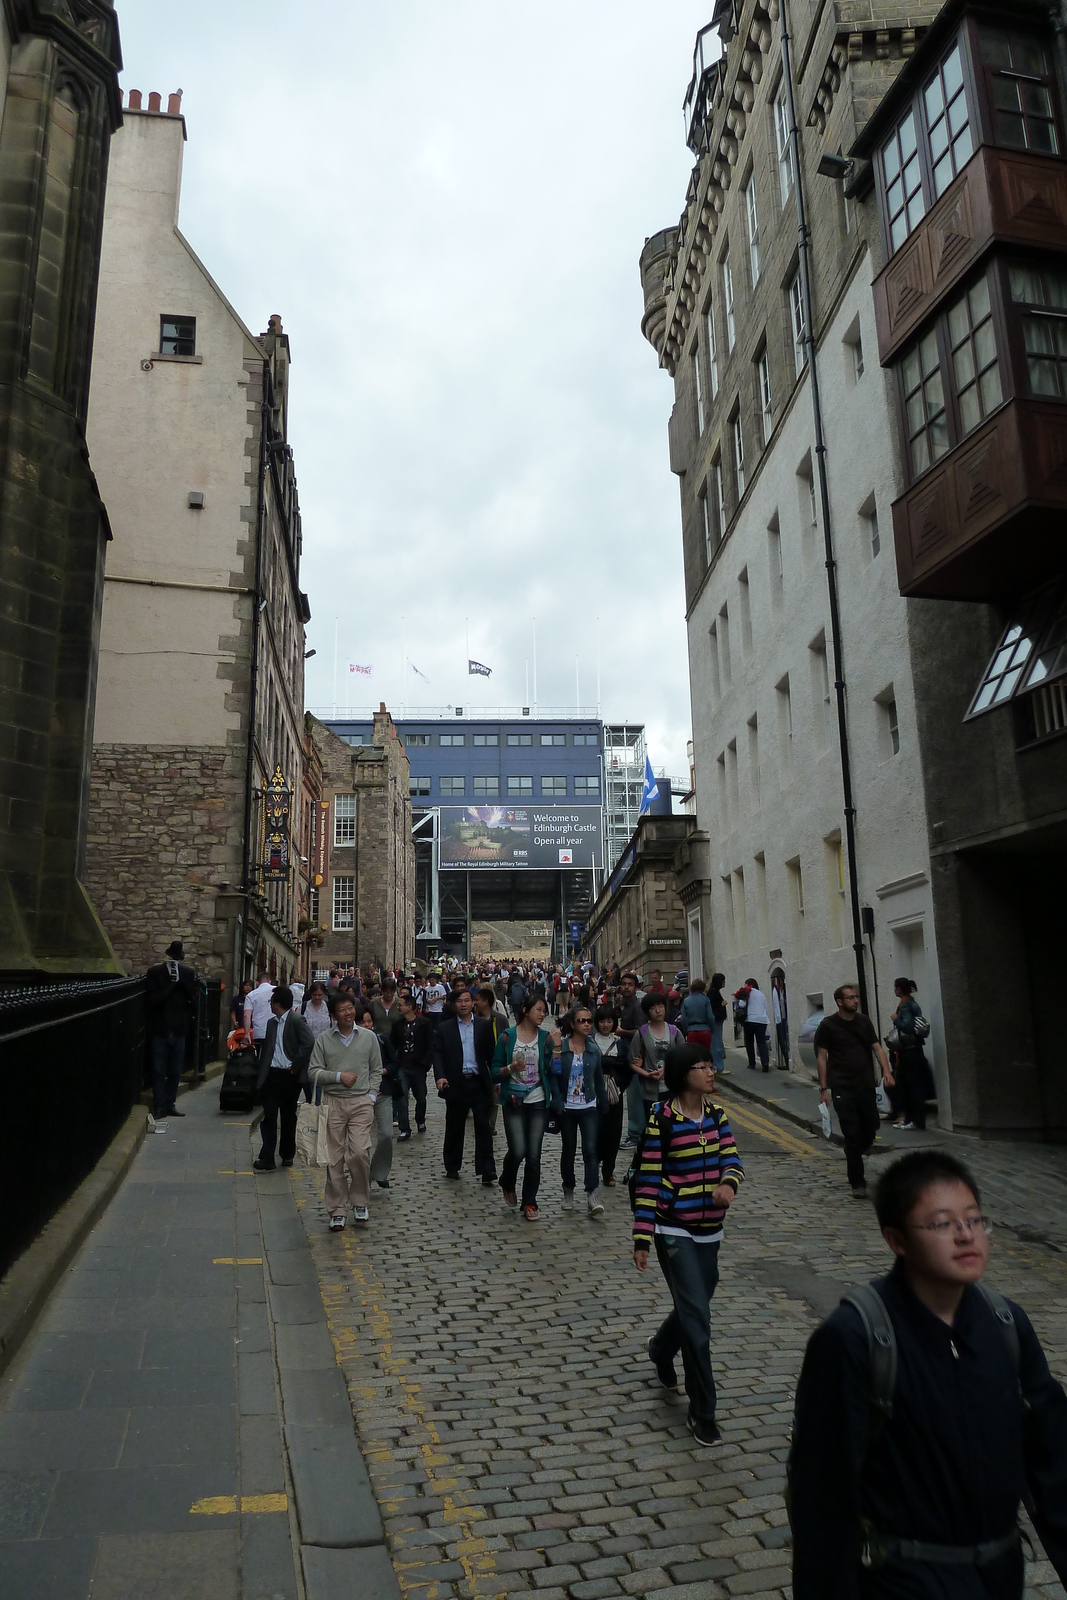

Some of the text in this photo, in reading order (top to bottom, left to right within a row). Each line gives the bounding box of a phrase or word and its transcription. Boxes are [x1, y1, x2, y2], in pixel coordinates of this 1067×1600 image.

[533, 814, 573, 822] Welcome
[533, 823, 597, 834] Edinburgh Castle
[533, 837, 583, 846] Open all year
